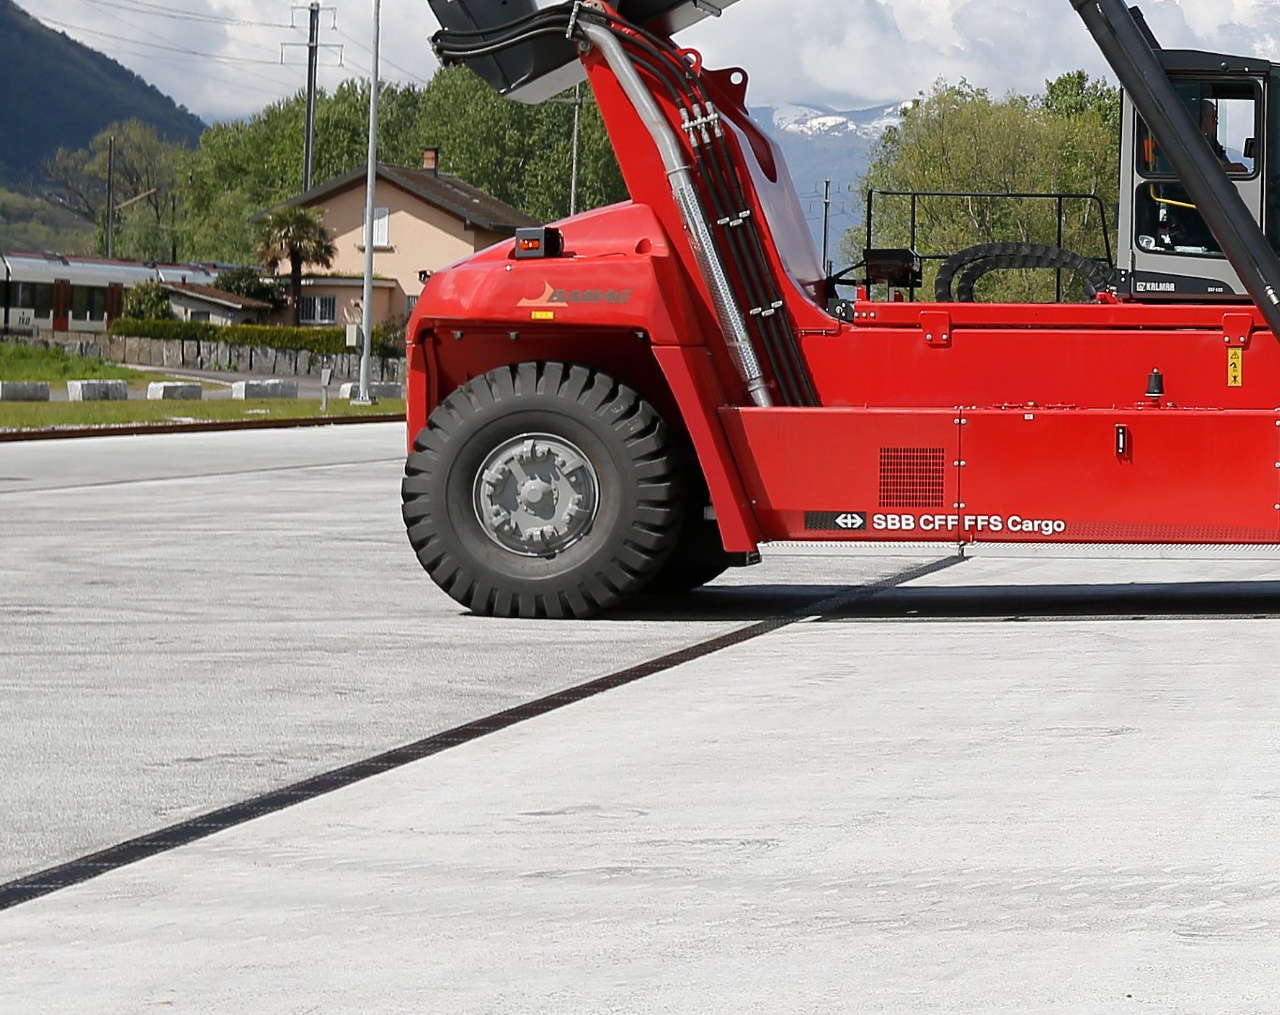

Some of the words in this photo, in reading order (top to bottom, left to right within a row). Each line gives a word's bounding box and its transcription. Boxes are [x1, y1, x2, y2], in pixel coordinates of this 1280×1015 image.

[1146, 282, 1175, 292] KALMAR
[873, 514, 915, 531] SBB
[919, 514, 959, 531] CFF
[964, 515, 1003, 532] FFS
[1007, 516, 1066, 535] Cargo
